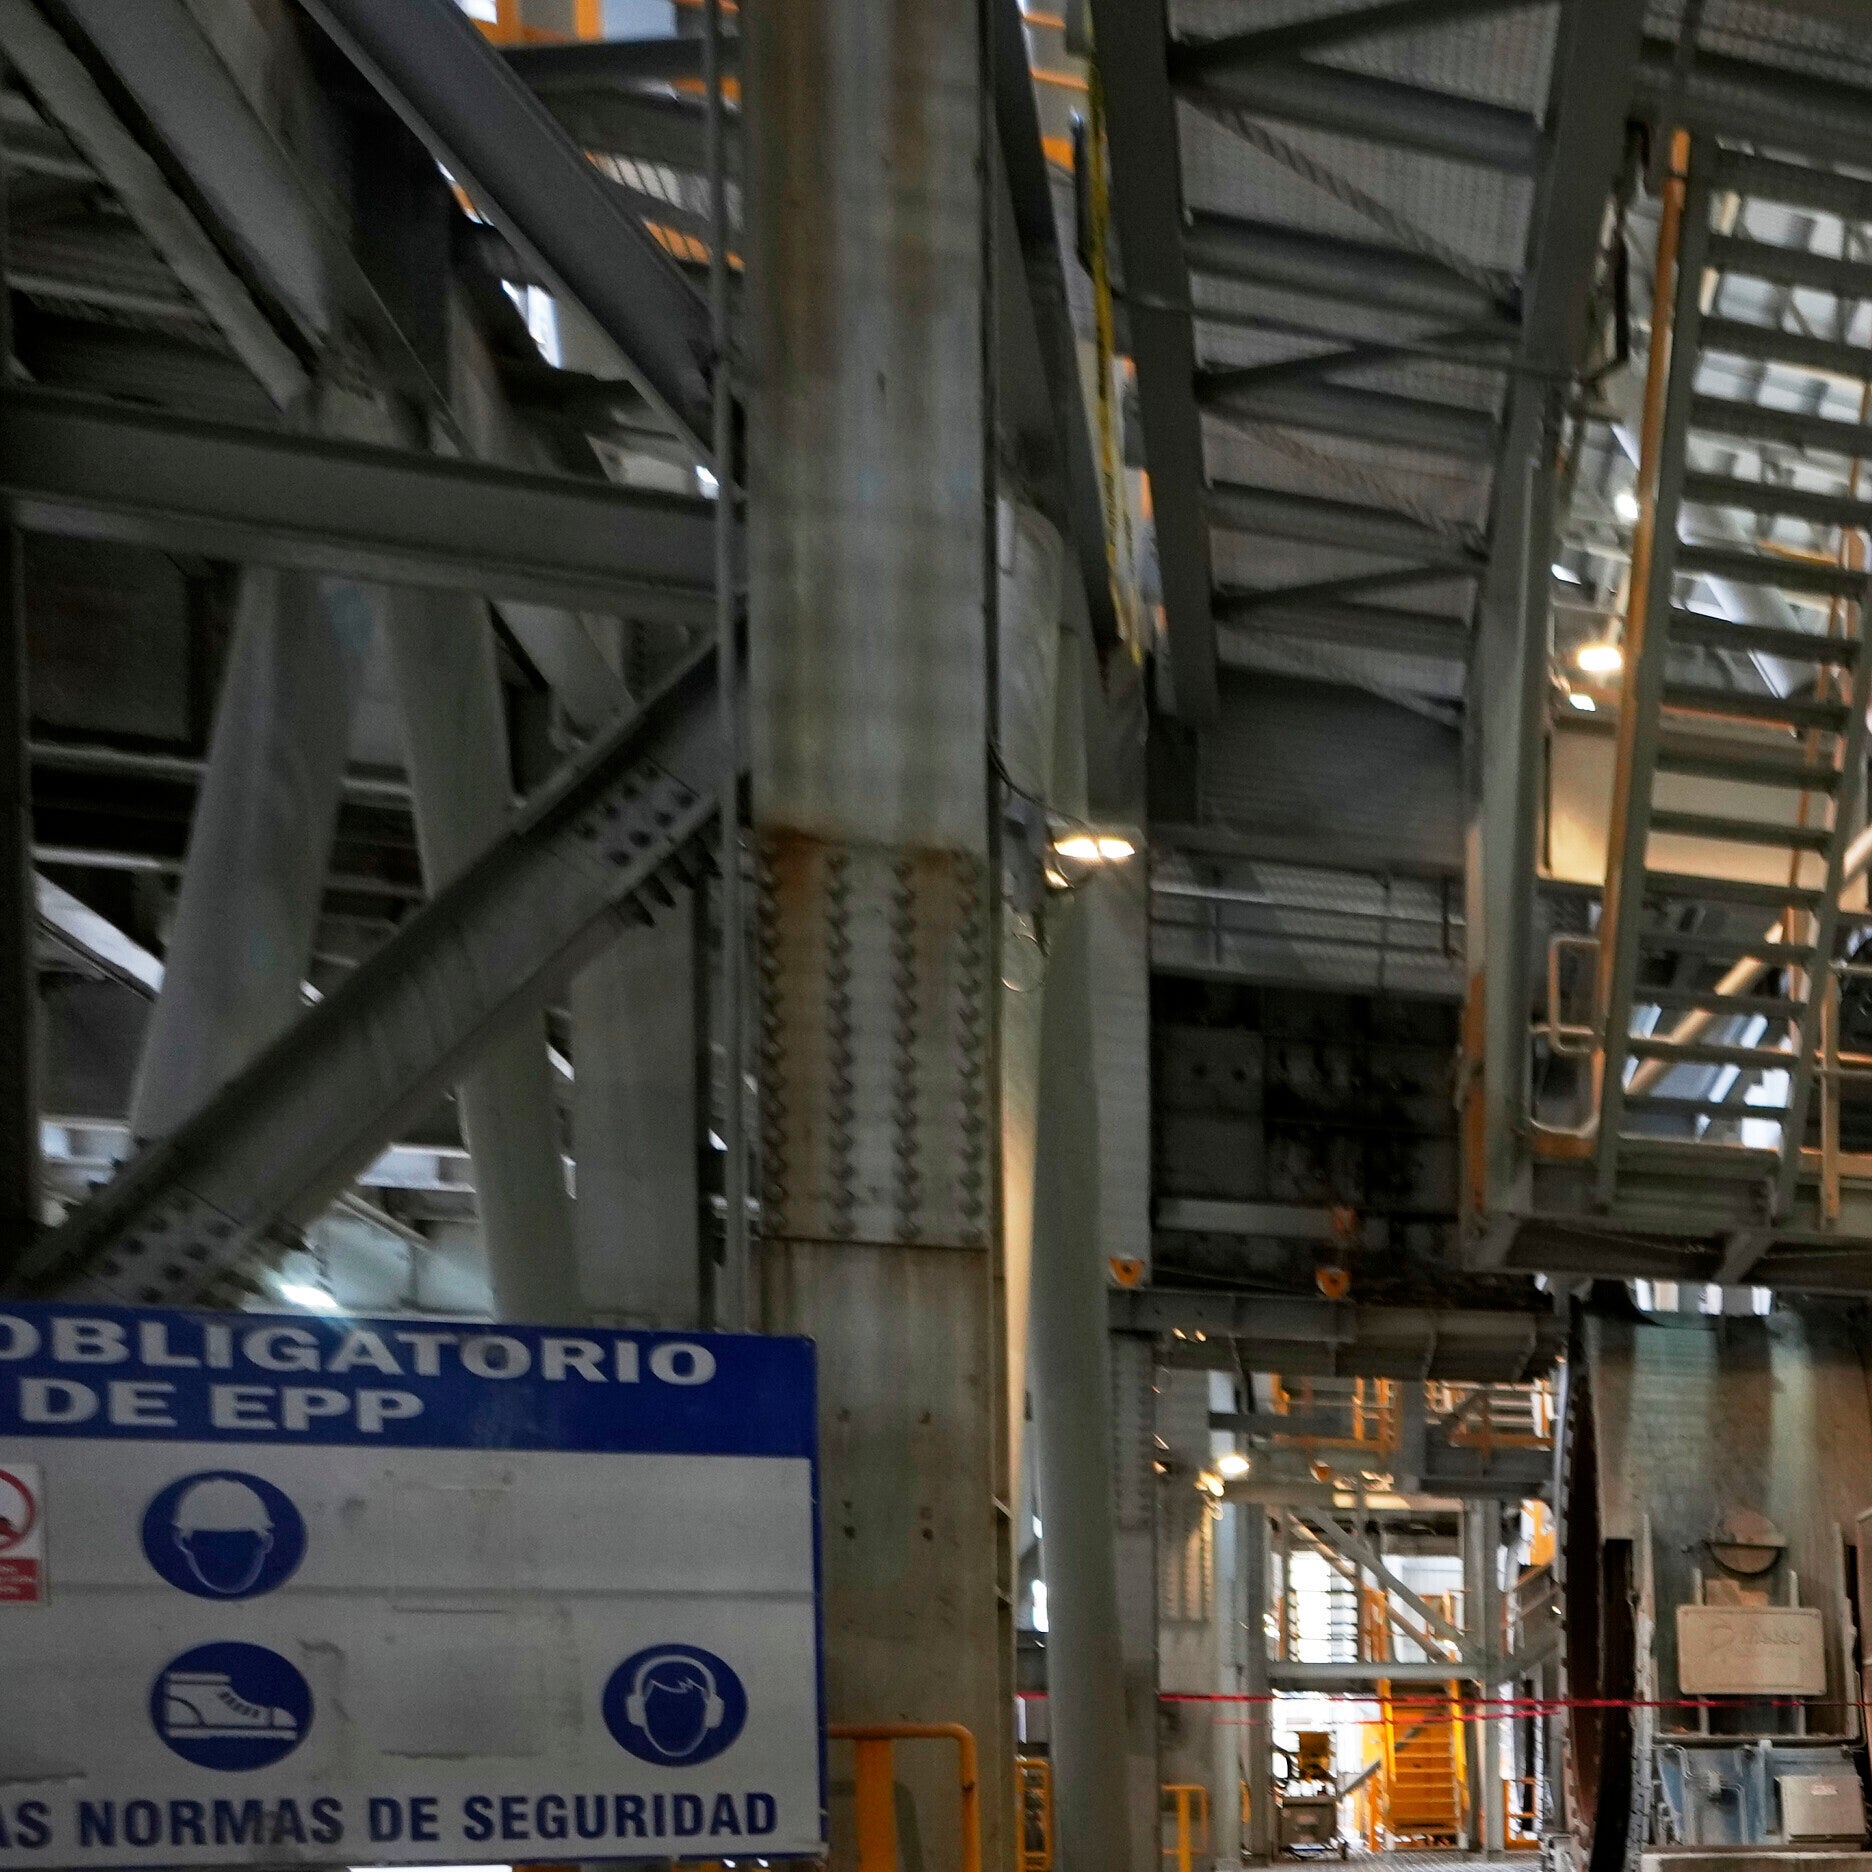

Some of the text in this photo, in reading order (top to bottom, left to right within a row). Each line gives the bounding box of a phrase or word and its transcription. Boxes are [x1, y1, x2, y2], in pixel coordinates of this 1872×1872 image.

[0, 1313, 717, 1387] OBLIGATORIO
[19, 1377, 425, 1434] DE EPP
[0, 1792, 778, 1850] S NORMAS DE SEGURIDAD
